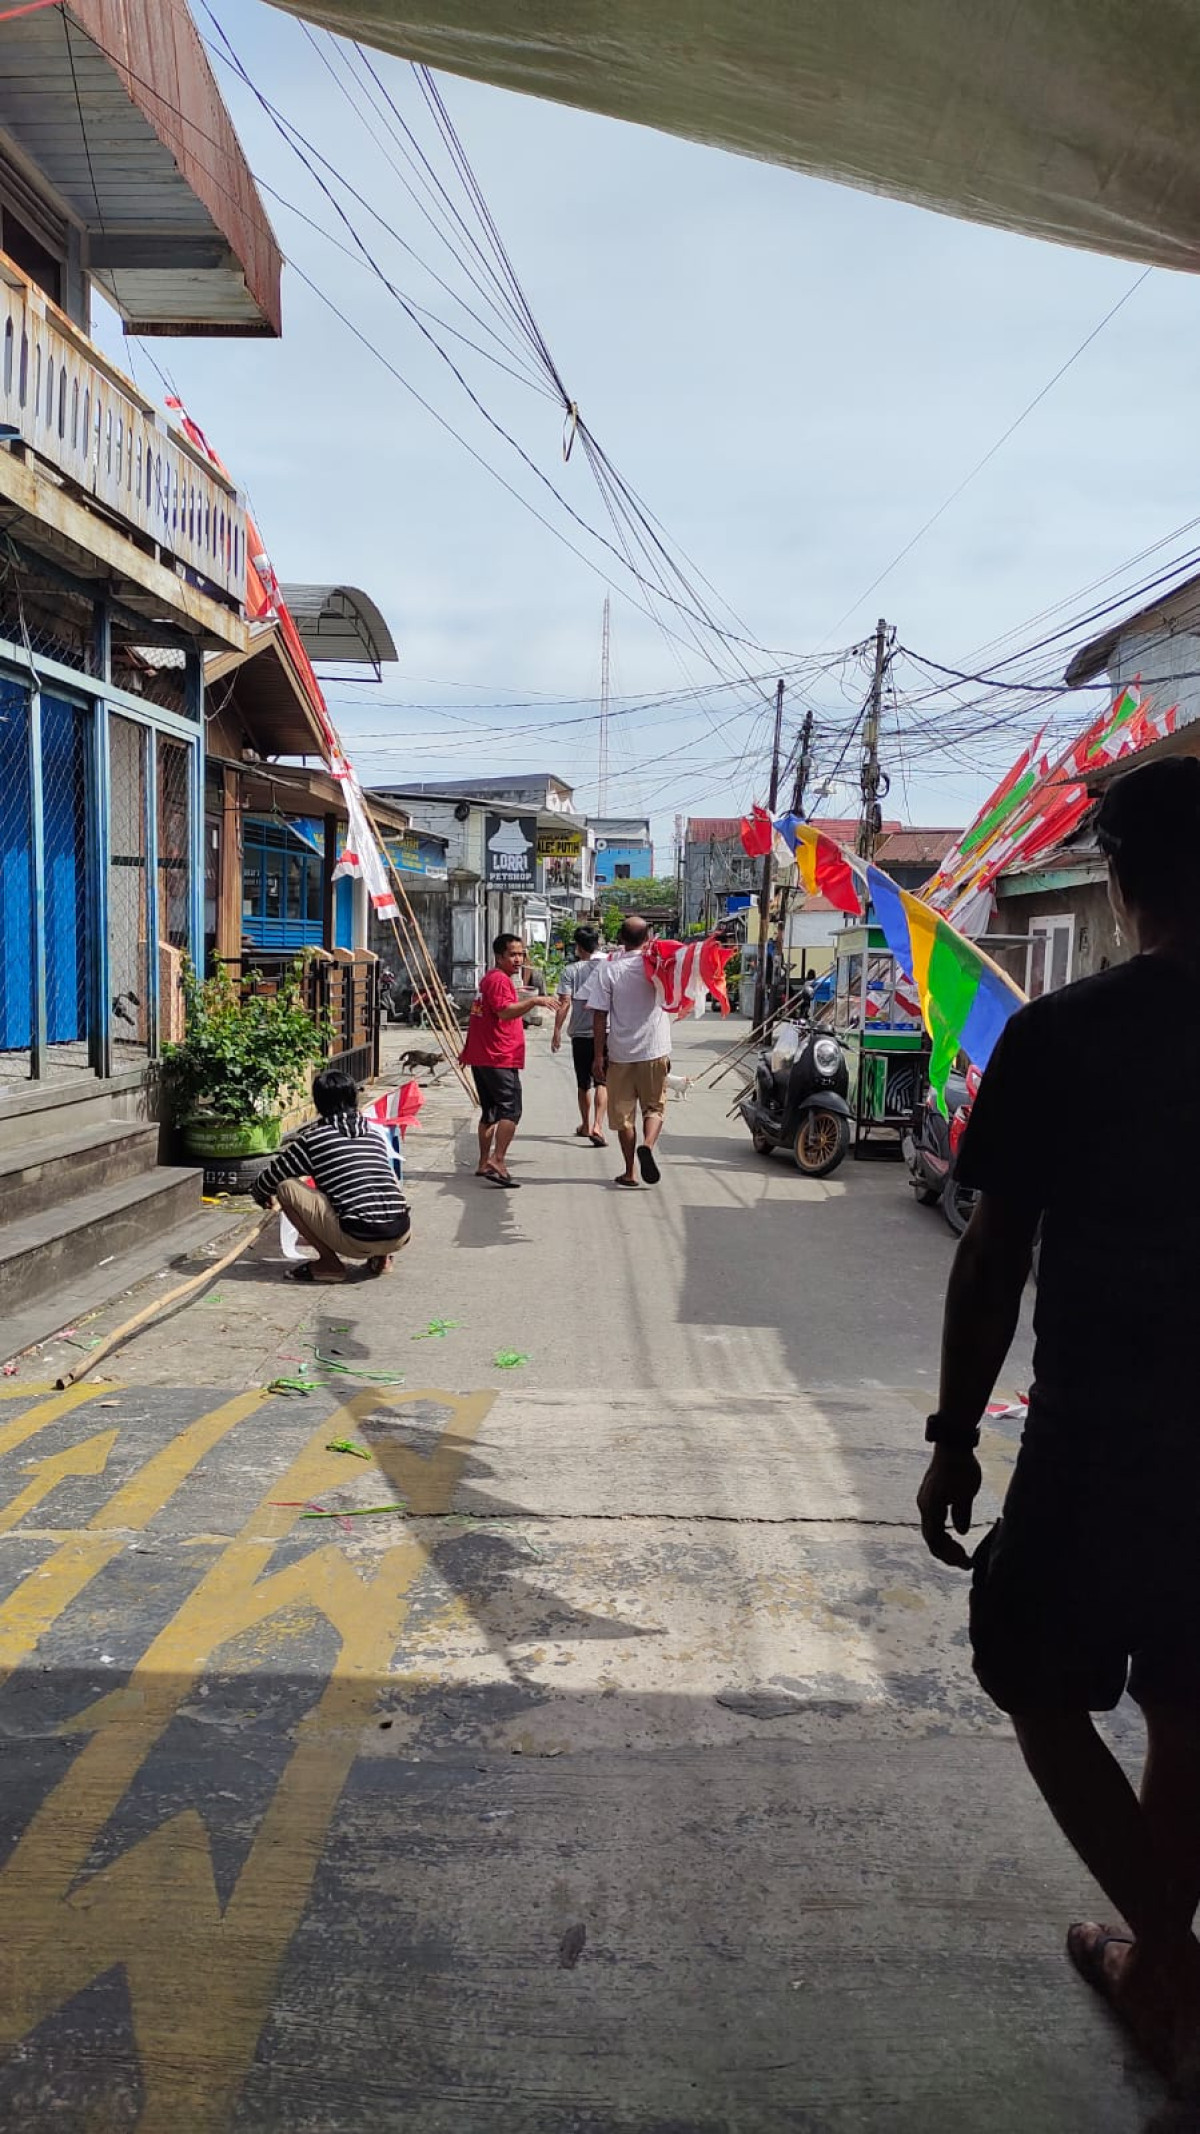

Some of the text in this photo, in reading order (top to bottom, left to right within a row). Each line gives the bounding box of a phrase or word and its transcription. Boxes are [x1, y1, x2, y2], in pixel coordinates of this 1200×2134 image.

[557, 841, 579, 853] PUTIH
[493, 854, 528, 871] LORRI
[489, 873, 532, 881] PETSHOP
